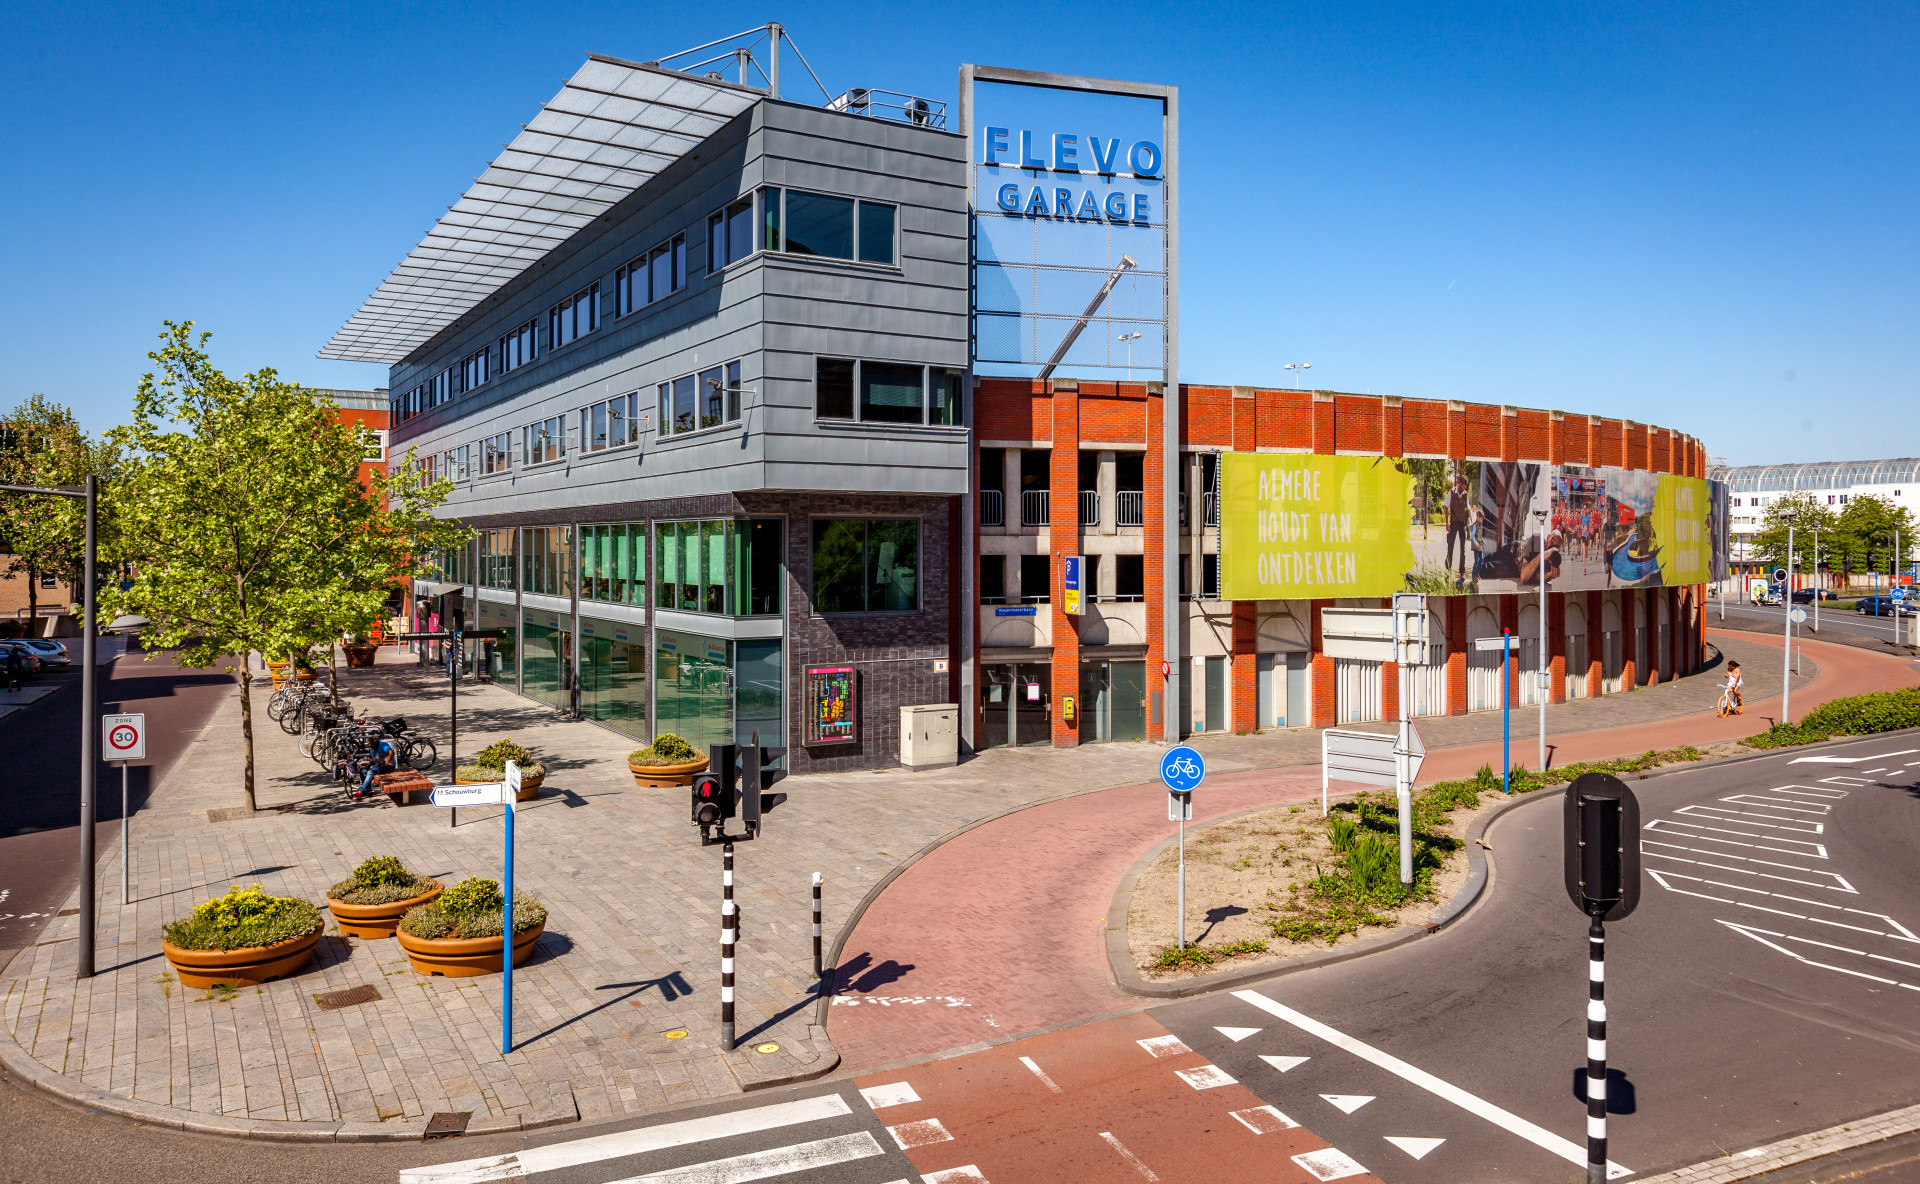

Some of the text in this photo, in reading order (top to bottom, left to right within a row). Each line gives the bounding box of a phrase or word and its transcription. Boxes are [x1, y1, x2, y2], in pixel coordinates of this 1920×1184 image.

[984, 125, 1163, 177] FLEVO
[996, 183, 1148, 221] GARAGE
[1258, 468, 1321, 501] ALMERE
[1258, 510, 1351, 543] HOUDT VAN
[1258, 551, 1356, 585] ONTDEKKEN
[115, 732, 133, 742] 30
[444, 788, 482, 796] Schouwburg
